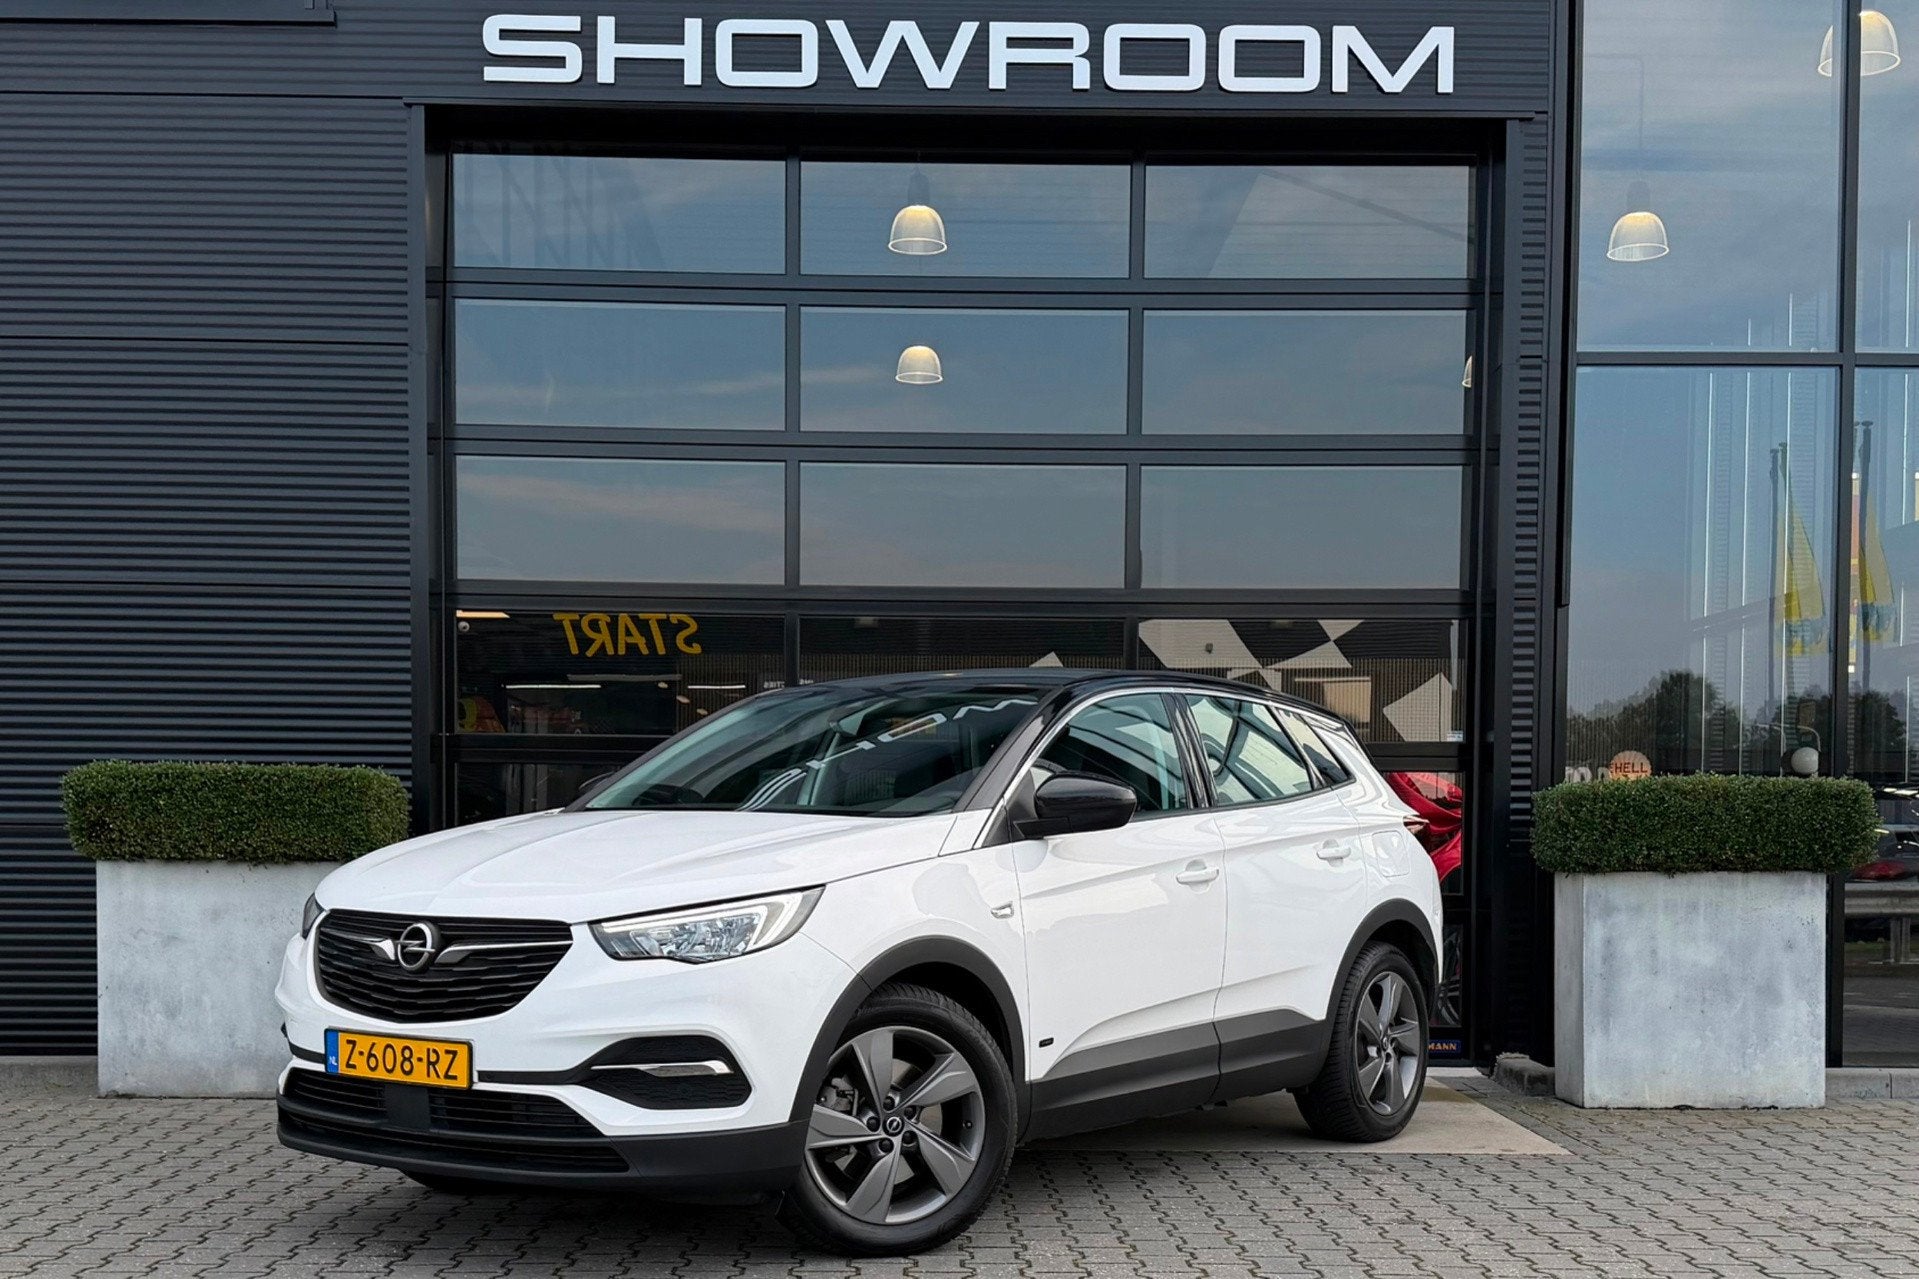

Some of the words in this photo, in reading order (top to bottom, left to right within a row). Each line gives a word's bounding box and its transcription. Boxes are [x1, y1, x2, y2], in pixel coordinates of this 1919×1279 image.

[484, 15, 1454, 94] SHOWROOM
[329, 1055, 338, 1066] NL
[345, 1039, 458, 1081] Z-608-RZ
